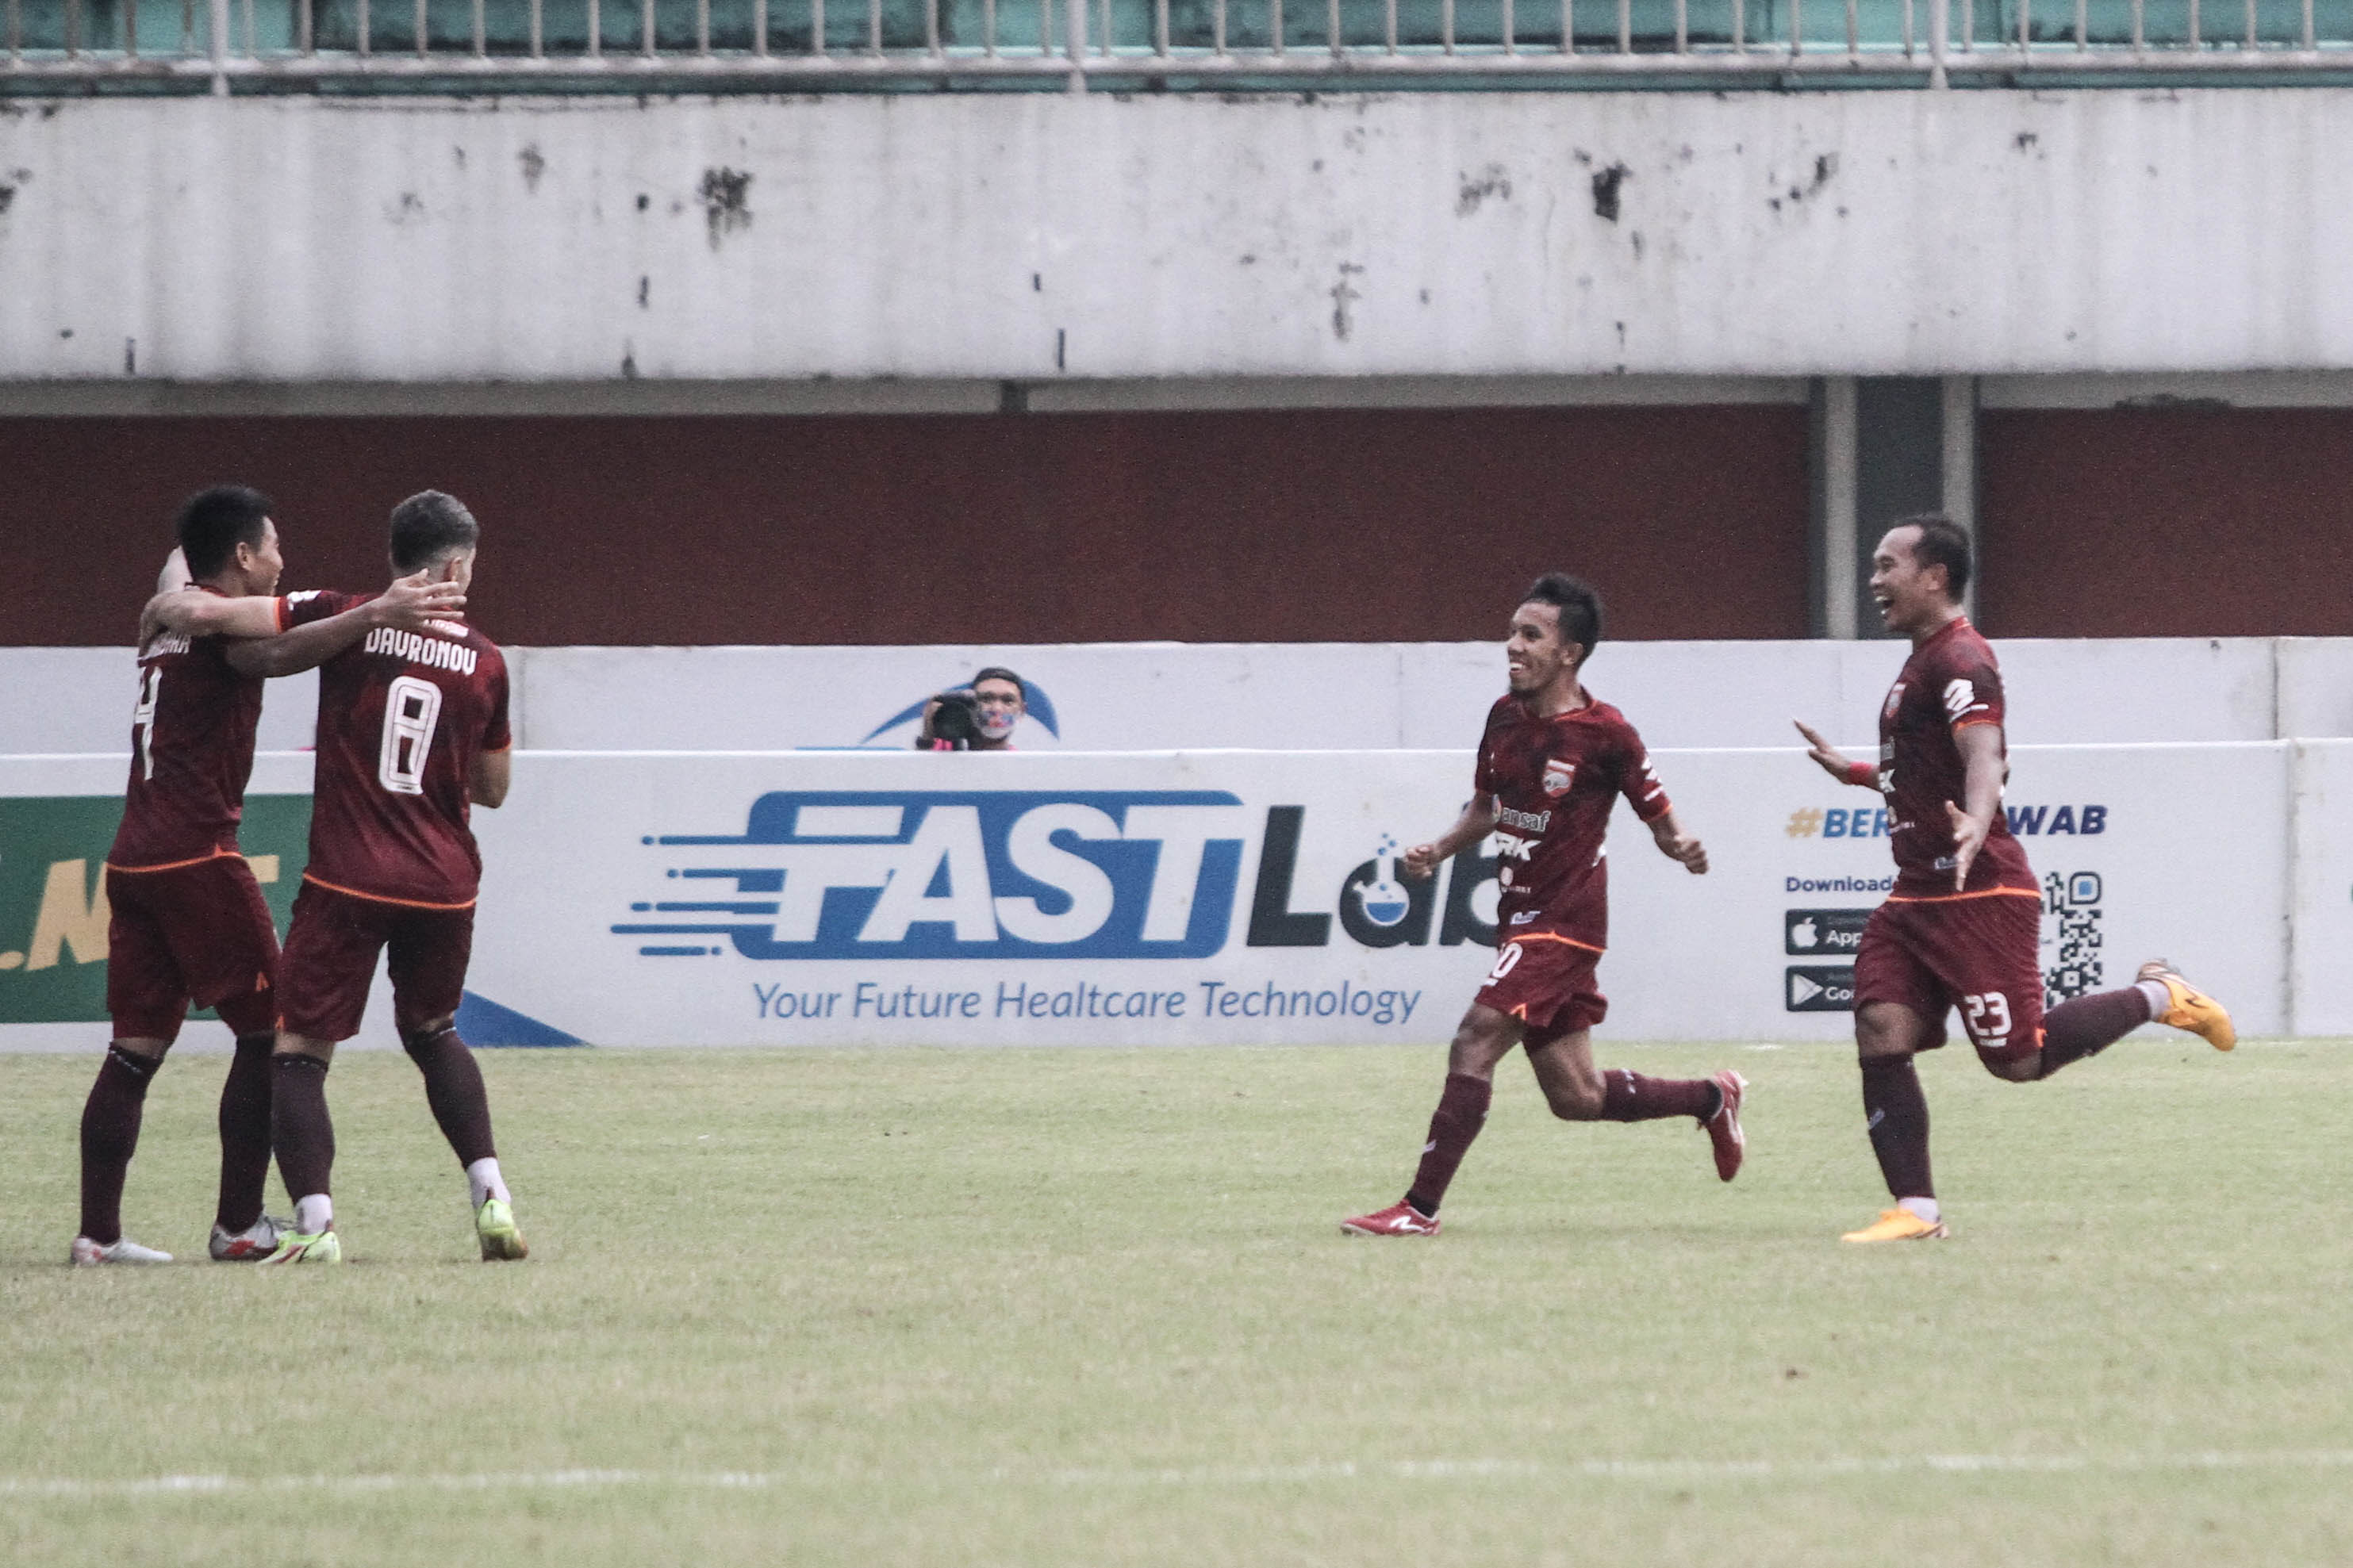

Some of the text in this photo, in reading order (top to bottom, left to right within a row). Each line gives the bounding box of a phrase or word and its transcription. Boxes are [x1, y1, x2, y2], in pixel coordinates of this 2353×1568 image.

[365, 627, 478, 676] DAVRONOV
[378, 676, 443, 795] 8
[1786, 876, 1894, 892] Download
[753, 980, 1422, 1025] Your Future Healtcare Technology
[1963, 991, 2013, 1037] 23
